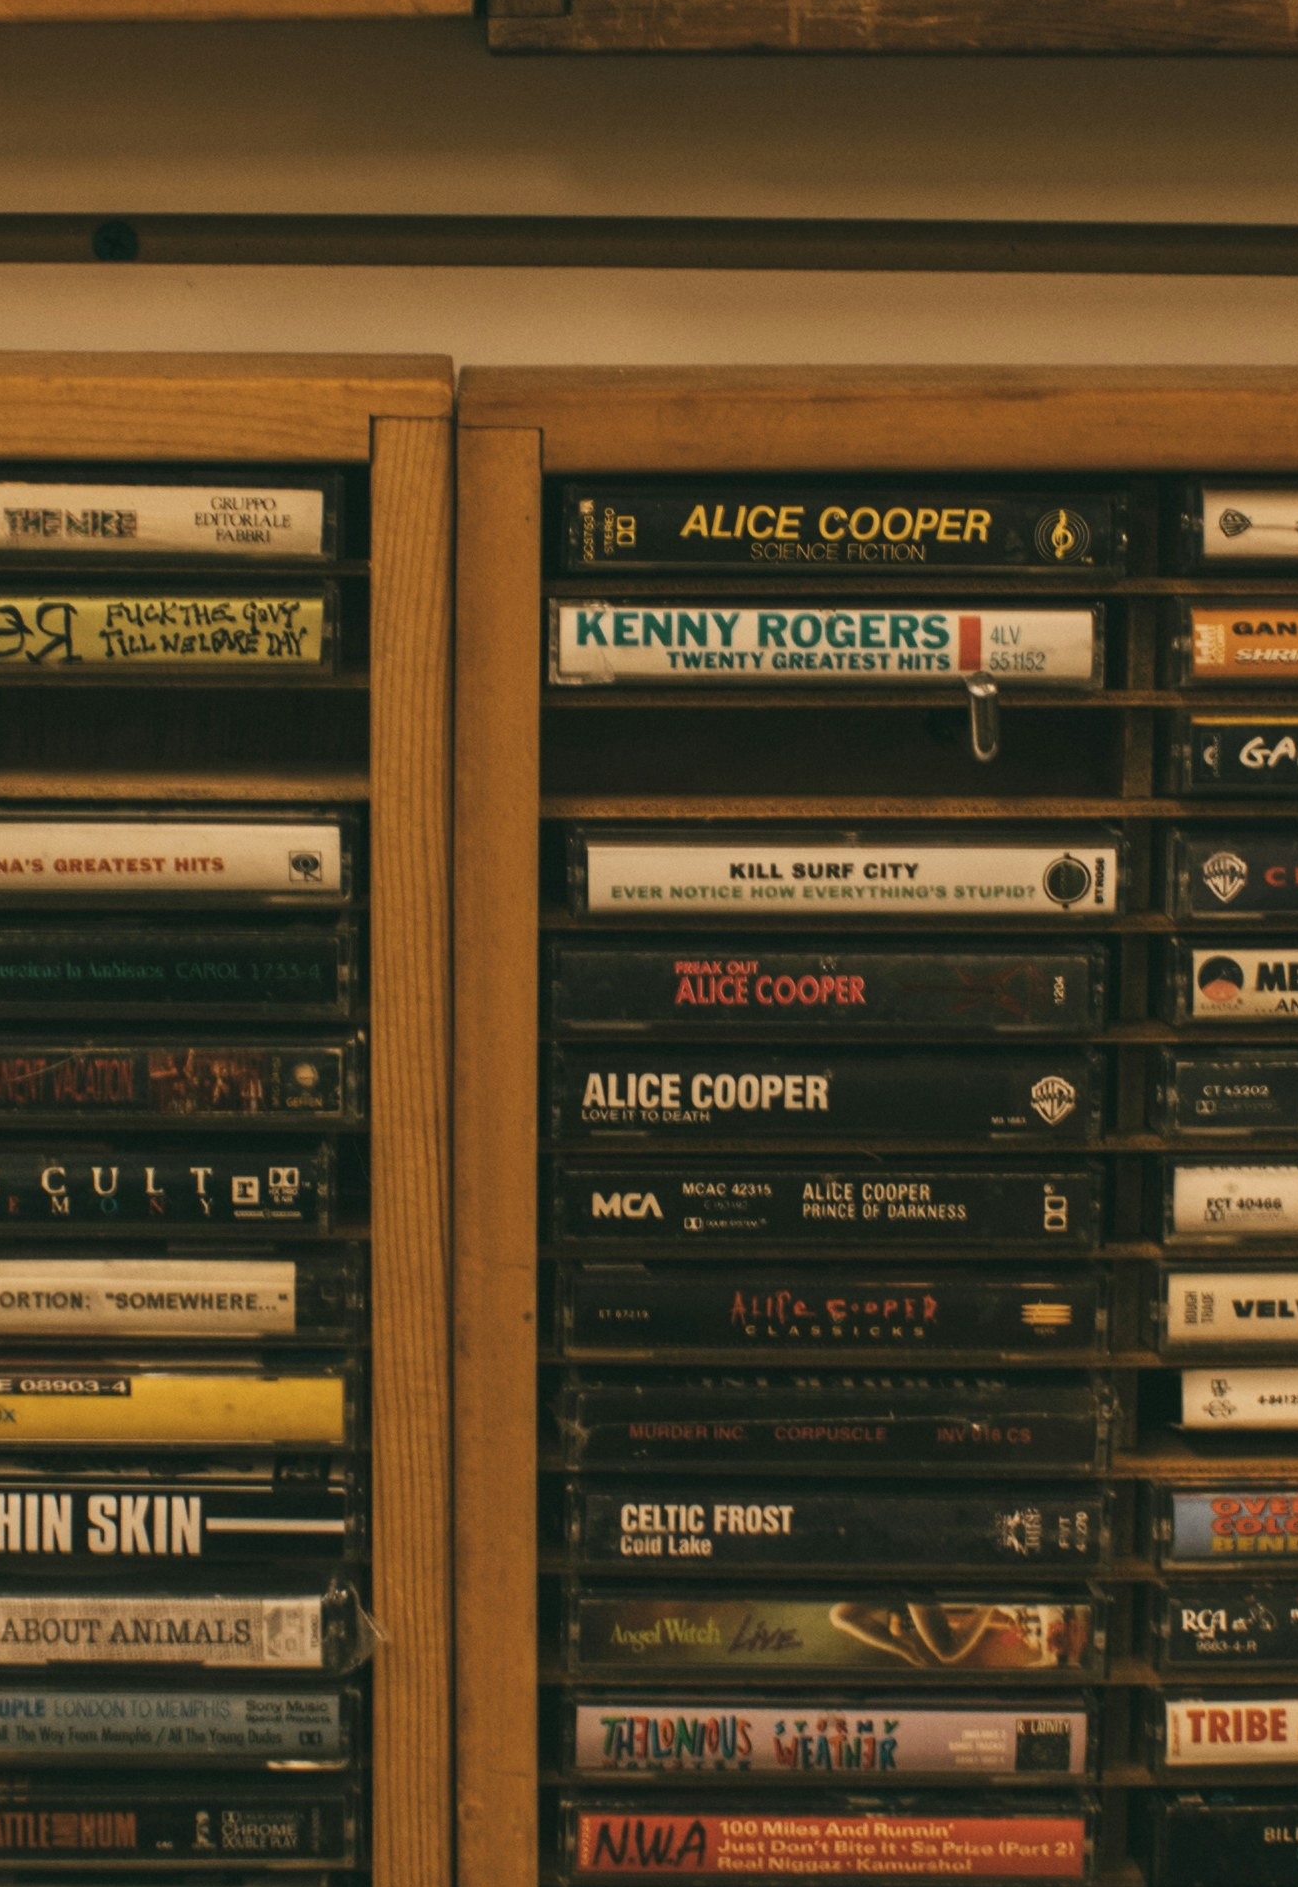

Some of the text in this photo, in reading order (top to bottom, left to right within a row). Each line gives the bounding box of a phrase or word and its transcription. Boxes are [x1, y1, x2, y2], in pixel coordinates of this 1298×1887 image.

[680, 506, 991, 542] ALICE COOPER
[750, 543, 925, 561] SCIENCE FICTION
[576, 613, 949, 648] KENNY ROGERS
[667, 652, 951, 670] TWENTY GREATEST HITS
[53, 856, 167, 874] GREATEST
[175, 856, 224, 872] HITS
[730, 862, 919, 879] KILL SURF CITY
[87, 1496, 202, 1555] SKIN
[621, 1504, 794, 1533] CELTIC FROST
[621, 1536, 712, 1556] Cold Lake
[1187, 1709, 1287, 1743] TRIBE
